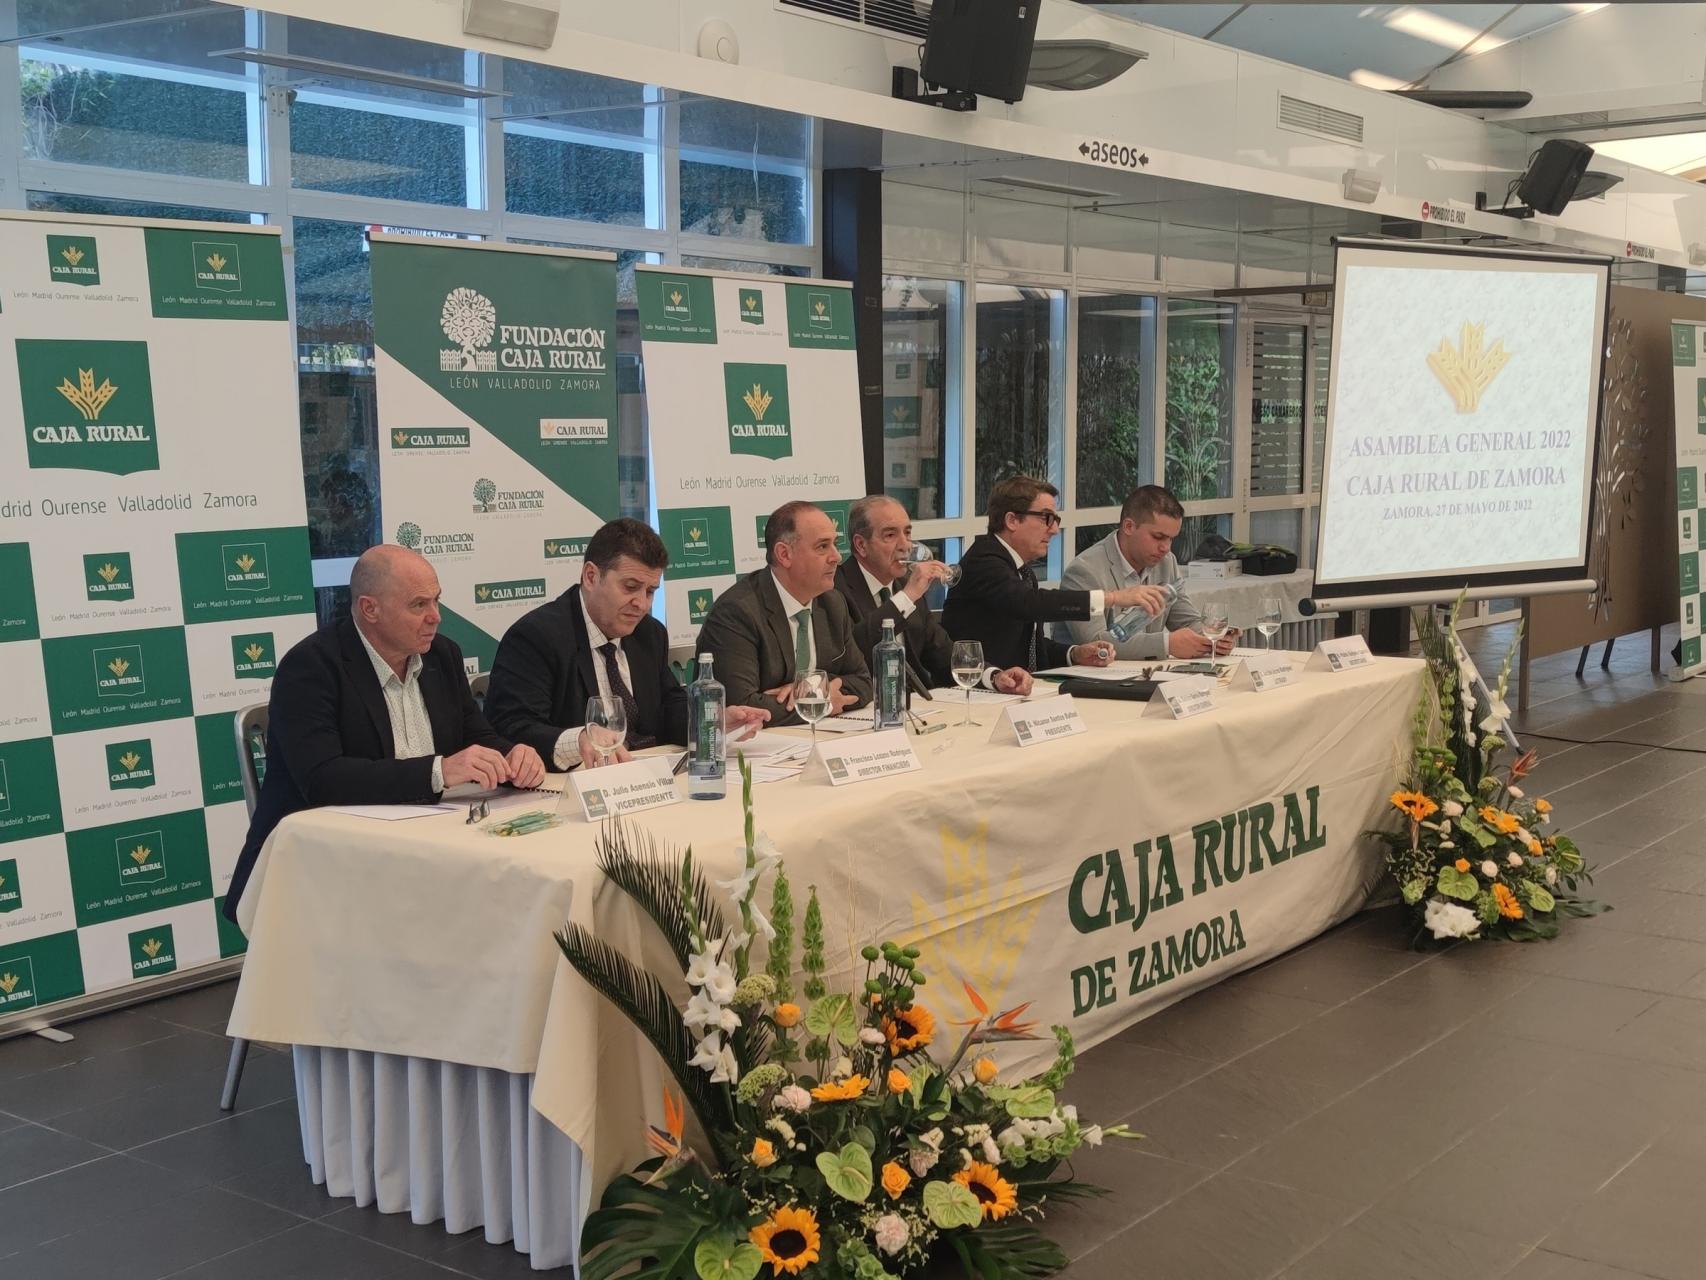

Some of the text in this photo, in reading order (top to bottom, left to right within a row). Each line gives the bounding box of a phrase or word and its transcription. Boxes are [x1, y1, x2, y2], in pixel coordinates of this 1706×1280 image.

[1090, 140, 1137, 168] aseos
[500, 325, 606, 350] FUNDACIÓN
[501, 350, 606, 370] CAJA RURAL
[450, 374, 600, 391] LEÓN VALLADOLID ZAMORA
[32, 426, 150, 444] CAJA RURAL
[556, 426, 606, 436] CAJA RURAL
[732, 424, 788, 438] CAJA RURAL
[410, 434, 468, 446] CAJA RURAL
[1349, 430, 1572, 457] ASAMBLEA GENERAL 2022
[680, 472, 840, 490] León Madrid Ourense Valladolid Zamora
[1346, 466, 1566, 496] CAJA RURAL DE ZAMORA
[498, 490, 544, 500] FUNDACIÓN
[0, 492, 258, 518] drid Ourense Valladolid Zamora
[498, 500, 544, 510] CAJA RURAL
[1436, 504, 1447, 516] 27
[1450, 502, 1462, 516] DE
[1464, 500, 1496, 515] MAYO
[1498, 500, 1512, 512] DE
[1514, 499, 1533, 512] 2022
[424, 532, 474, 544] FUNDACIÓN
[424, 544, 474, 554] CAJA RURAL
[560, 544, 580, 554] CAJA
[244, 572, 266, 580] RURAL
[89, 583, 132, 592] CAJA RURAL
[492, 586, 544, 599] CAJA RURAL
[253, 661, 274, 670] RURAL
[100, 676, 142, 687] CAJA RURAL
[858, 760, 911, 776] DIRECTOR FINANCIERO
[111, 769, 152, 782] CAJA RURAL
[613, 786, 629, 796] Julio
[616, 791, 674, 810] VICEPRESIDENTE
[1068, 784, 1326, 934] CAJA RURAL
[122, 862, 162, 876] CAJA RURAL
[0, 892, 19, 900] URAL
[134, 955, 174, 970] CAJA RURAL
[1070, 908, 1246, 1018] DE ZAMORA
[8, 990, 33, 1002] RURAL
